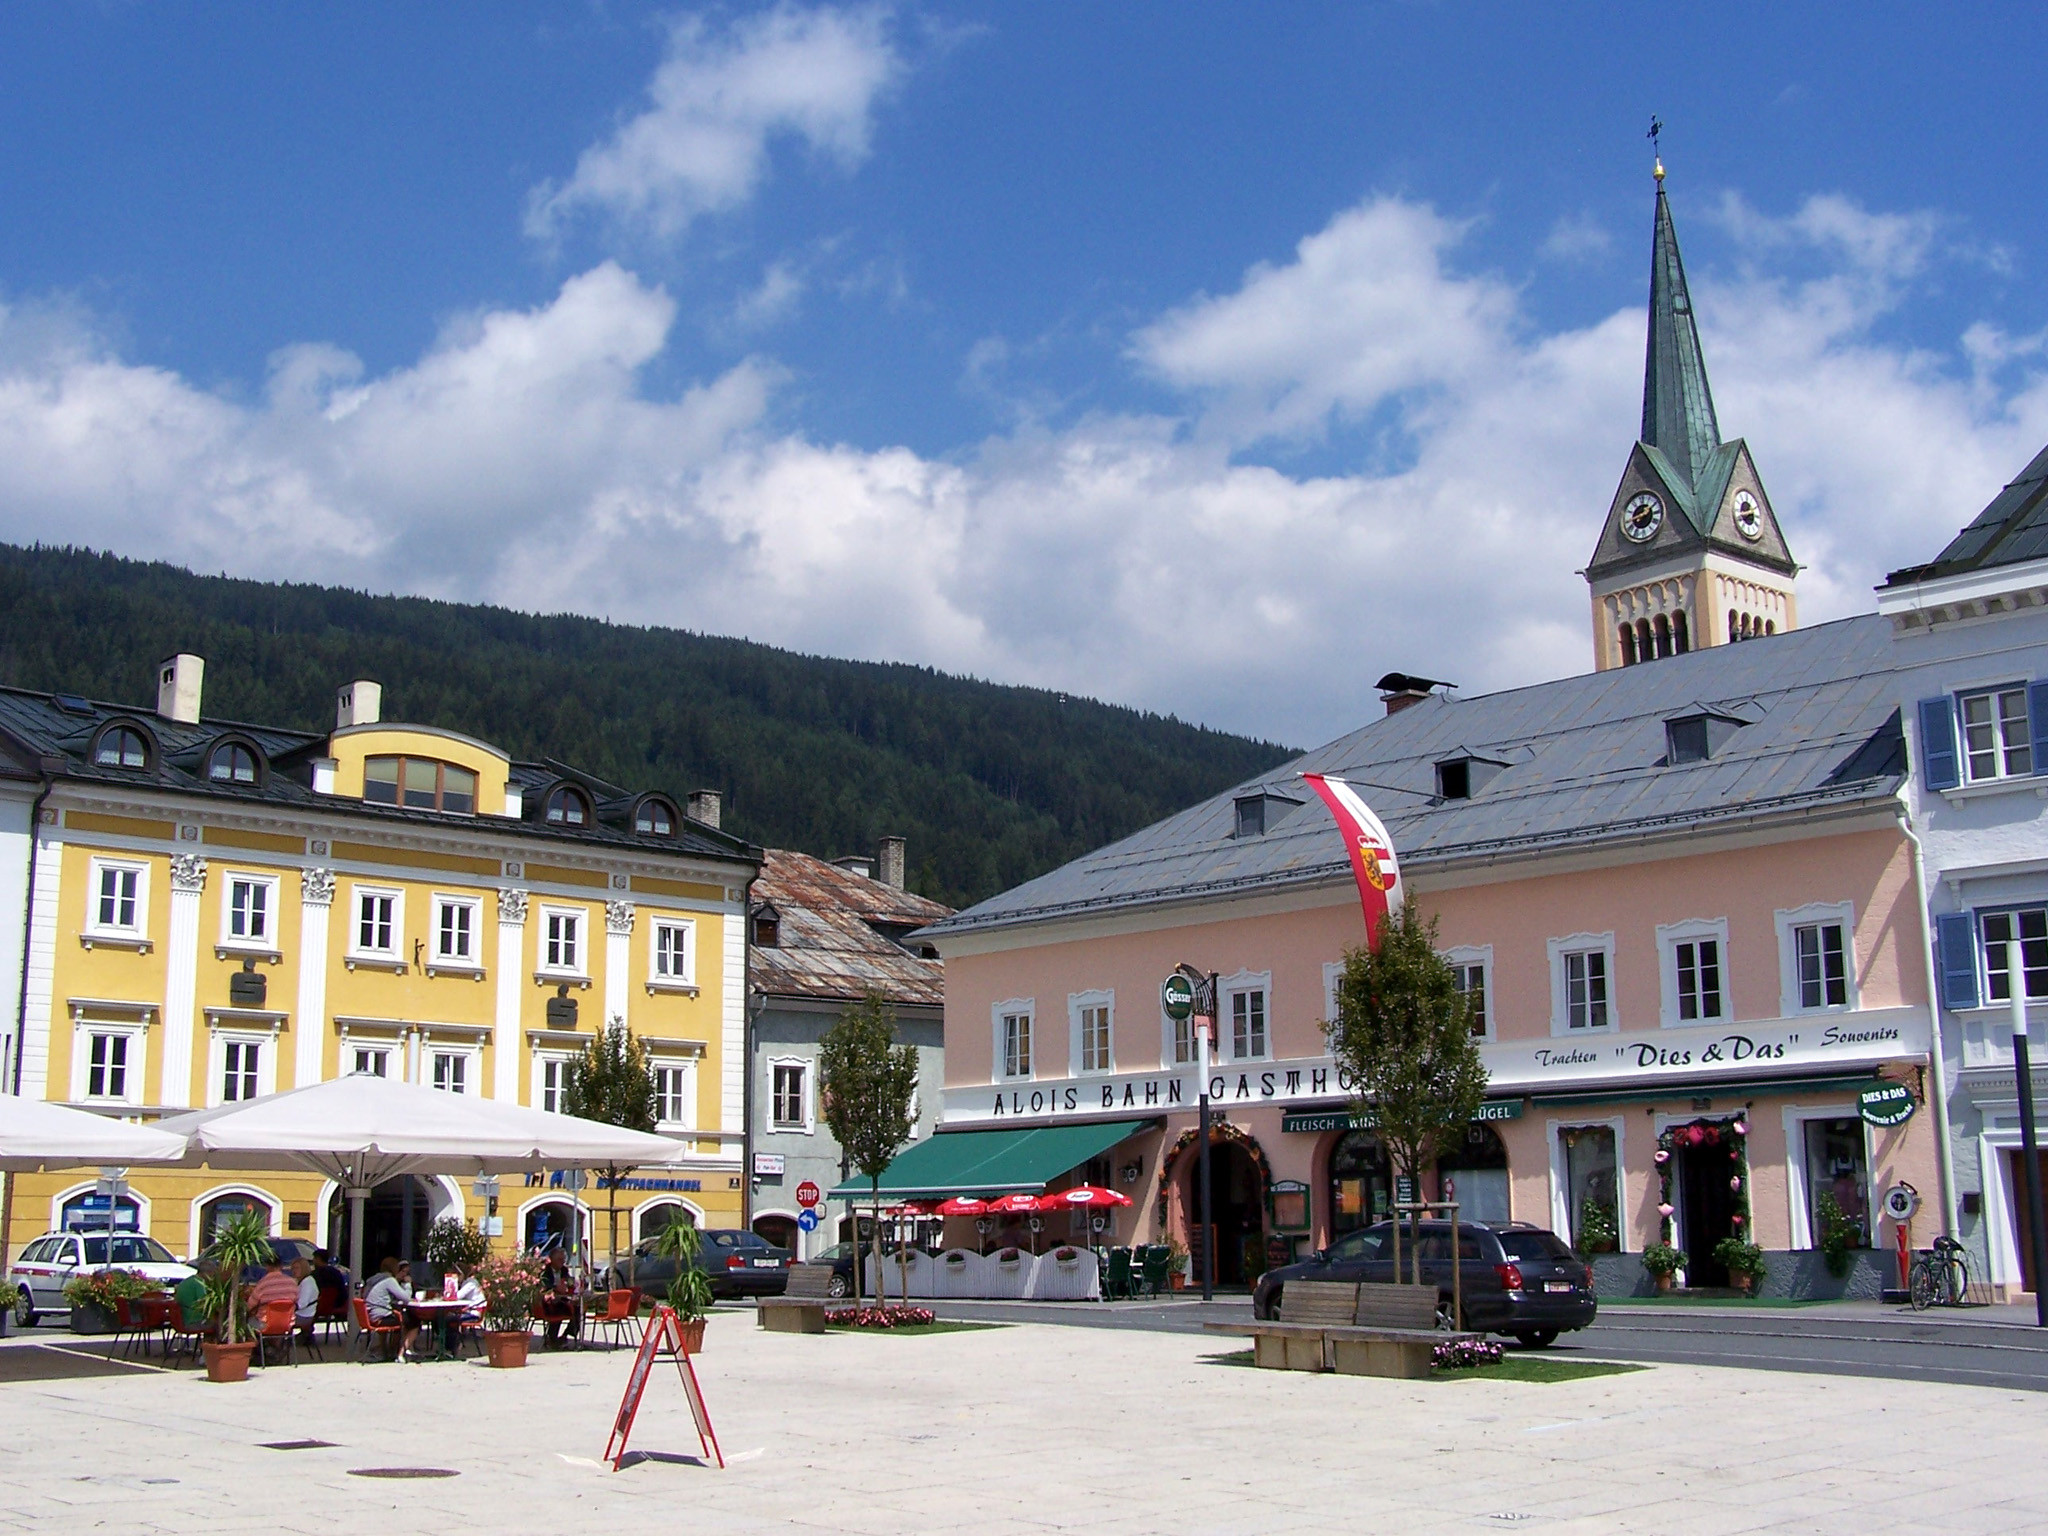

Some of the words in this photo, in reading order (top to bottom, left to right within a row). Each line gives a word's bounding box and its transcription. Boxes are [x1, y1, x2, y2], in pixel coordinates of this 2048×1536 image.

[1820, 1026, 1899, 1047] Souvenirs
[1534, 1048, 1597, 1067] Trachten
[993, 1087, 1078, 1115] ALOIS
[1101, 1079, 1182, 1108] BAHN
[1209, 1066, 1353, 1100] GASTHO
[1861, 1091, 1881, 1104] DIES
[1889, 1087, 1906, 1099] DAS
[1289, 1119, 1335, 1132] FLEISCH
[798, 1189, 818, 1201] STOP
